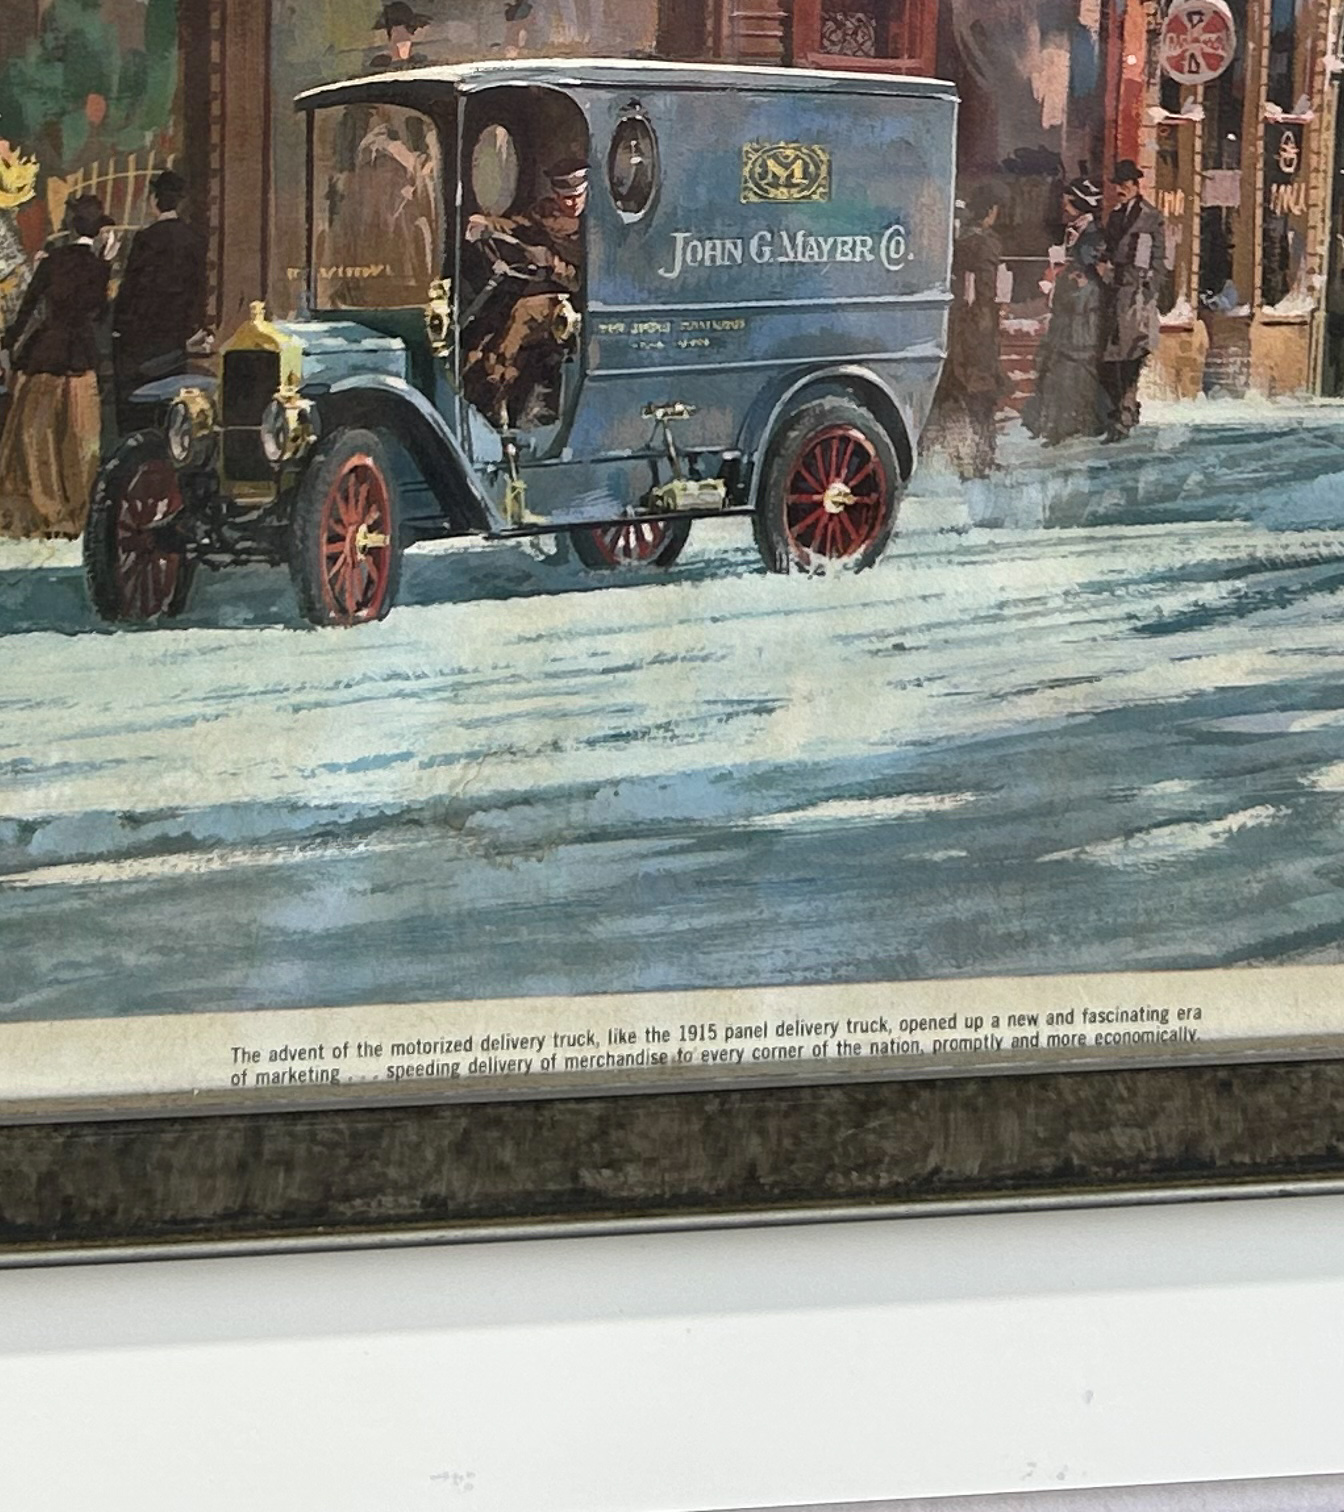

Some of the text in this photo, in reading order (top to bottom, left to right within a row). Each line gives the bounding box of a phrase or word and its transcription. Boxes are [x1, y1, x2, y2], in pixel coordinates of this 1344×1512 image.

[658, 231, 743, 279] JOHN
[778, 229, 875, 263] MAYER
[231, 1004, 1202, 1064] The advent of the motorized delivery truck, like the 1915 panel delivery truck, opened up a new and fascinating era
[231, 1071, 248, 1086] of
[256, 1066, 340, 1085] marketing
[387, 1059, 460, 1080] speeding
[468, 1055, 533, 1075] delivery
[541, 1054, 558, 1071] of
[565, 1049, 668, 1069] merchandise
[677, 1047, 692, 1063] to
[701, 1046, 744, 1063] every
[752, 1043, 803, 1061] corner
[812, 1040, 829, 1057] of
[837, 1038, 861, 1055] the
[870, 1038, 924, 1056] nation,
[933, 1034, 1003, 1054] promptly
[1011, 1031, 1039, 1048] and
[1047, 1029, 1086, 1047] more
[1095, 1024, 1201, 1045] economically.
